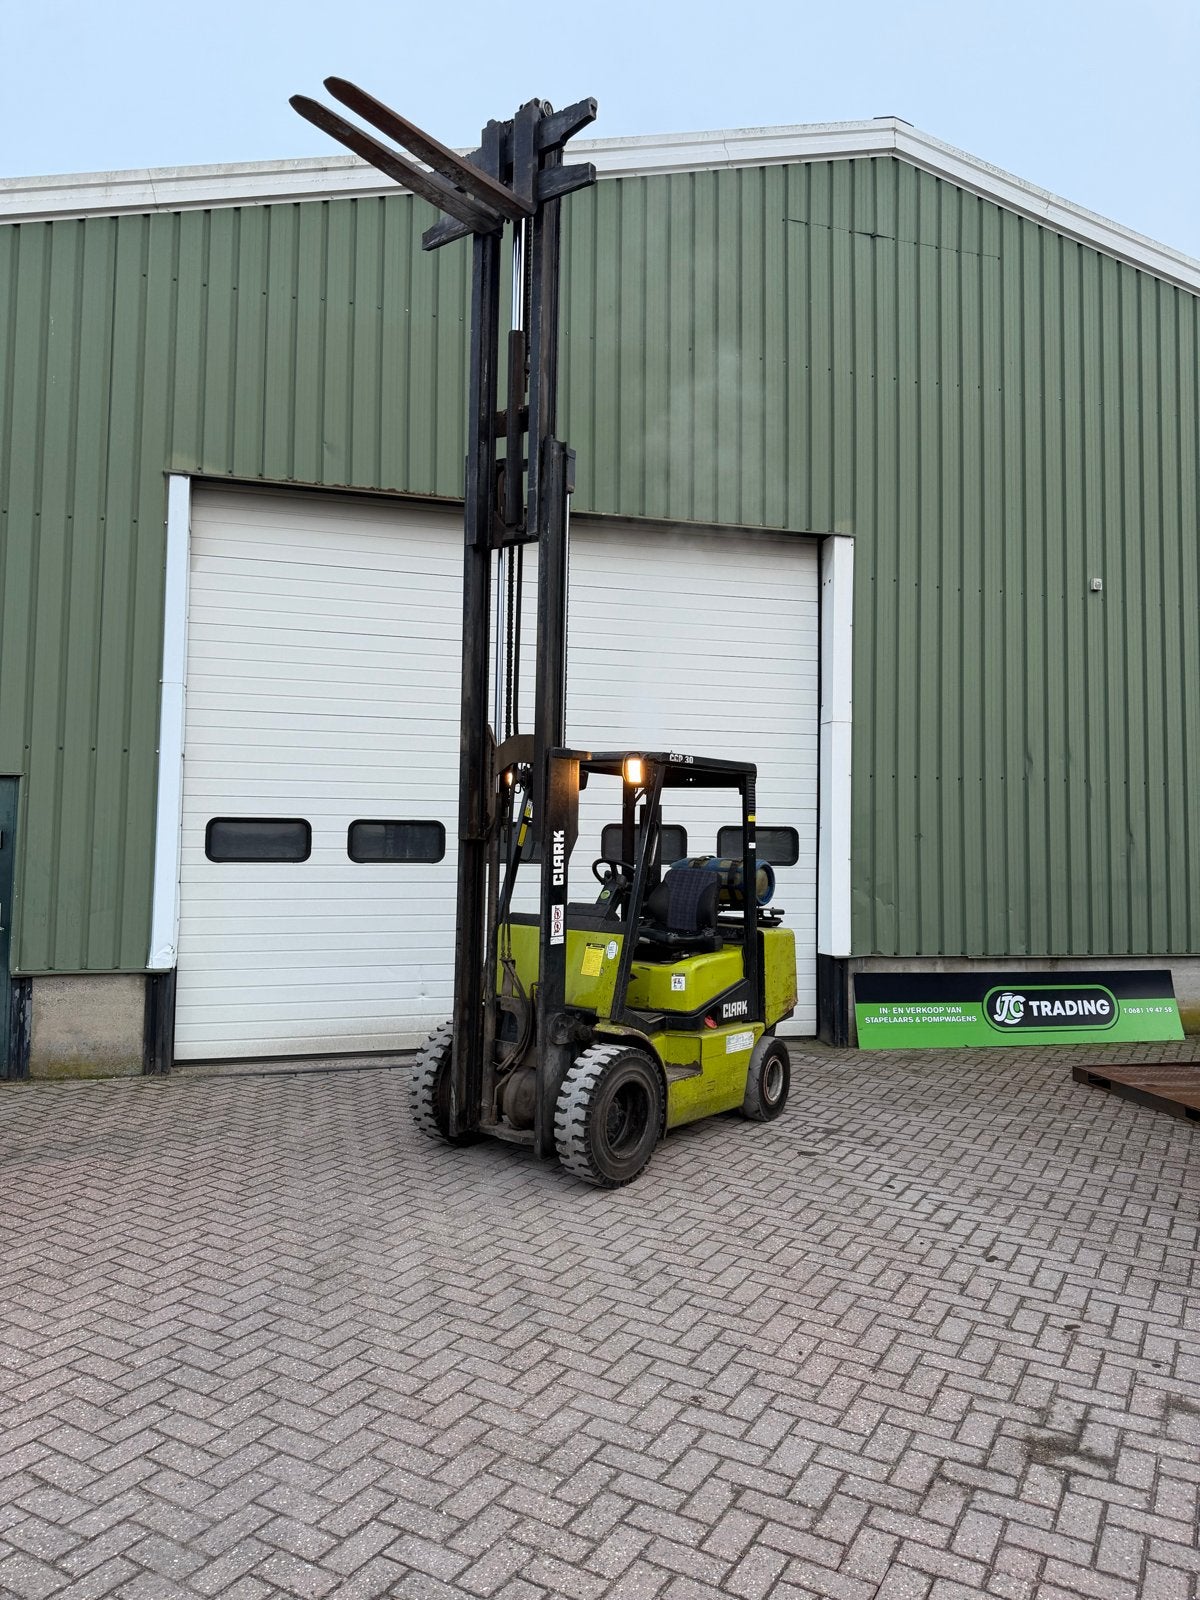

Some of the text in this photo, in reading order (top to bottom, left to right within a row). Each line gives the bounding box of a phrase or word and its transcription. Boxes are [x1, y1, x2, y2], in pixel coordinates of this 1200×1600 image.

[553, 830, 565, 886] CLARK
[722, 1000, 748, 1019] CLARK
[905, 1006, 944, 1014] VERKOOP
[1029, 999, 1110, 1017] TRADING
[865, 1016, 914, 1024] STAPELAARS
[922, 1015, 977, 1023] POMPWAGENS
